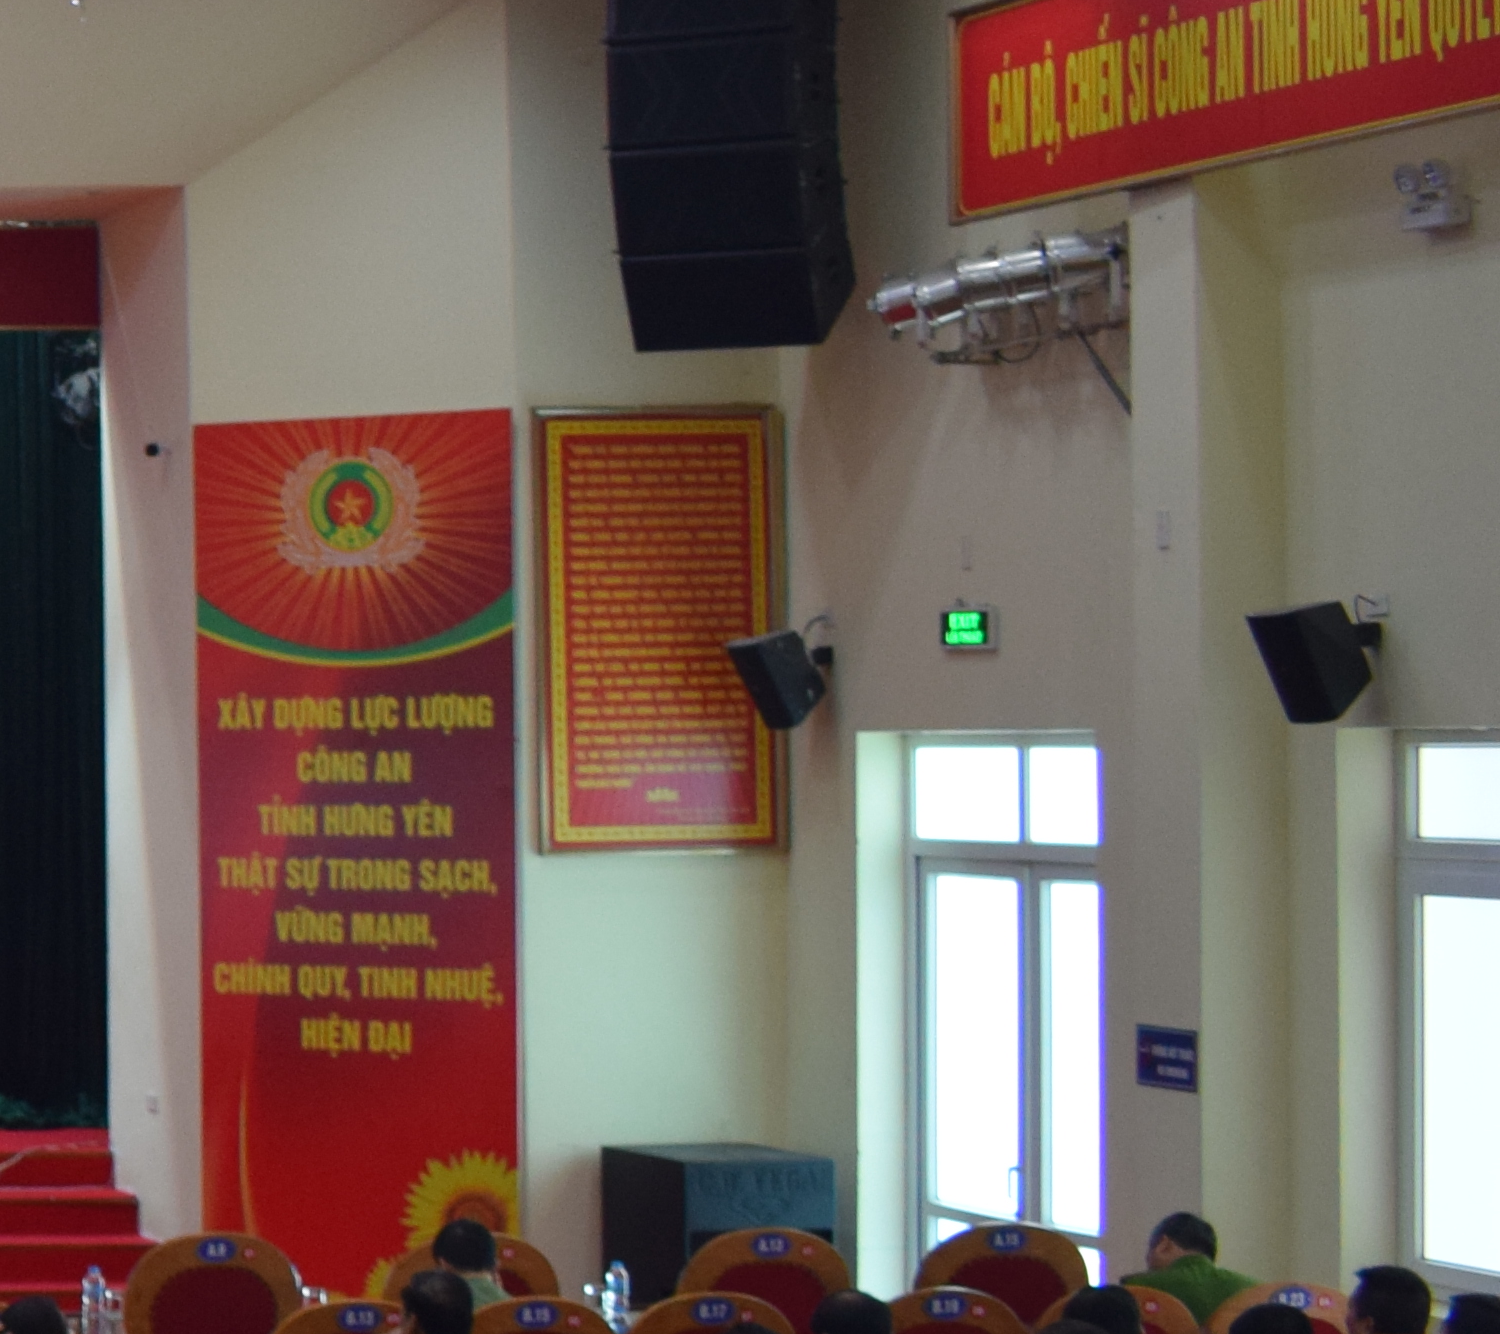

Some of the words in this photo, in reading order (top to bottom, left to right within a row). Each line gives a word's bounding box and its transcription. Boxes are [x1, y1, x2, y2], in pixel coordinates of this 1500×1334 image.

[988, 53, 1026, 159] CÁN
[1030, 41, 1062, 165] BỘ,
[1065, 15, 1123, 141] CHIẾN
[1128, 16, 1148, 124] SĨ
[1153, 6, 1210, 118] CÔNG
[1215, 6, 1245, 103] AN
[297, 745, 366, 782] CÔNG
[374, 751, 412, 782] AN
[259, 795, 316, 836] TỈNH
[324, 803, 394, 837] HƯNG
[402, 799, 453, 837] YÊN
[218, 852, 277, 895] THẬT
[286, 856, 322, 896] SỰ
[328, 858, 410, 890] TRONG
[419, 860, 498, 897] SẠCH,
[351, 913, 438, 951] MẠNH,
